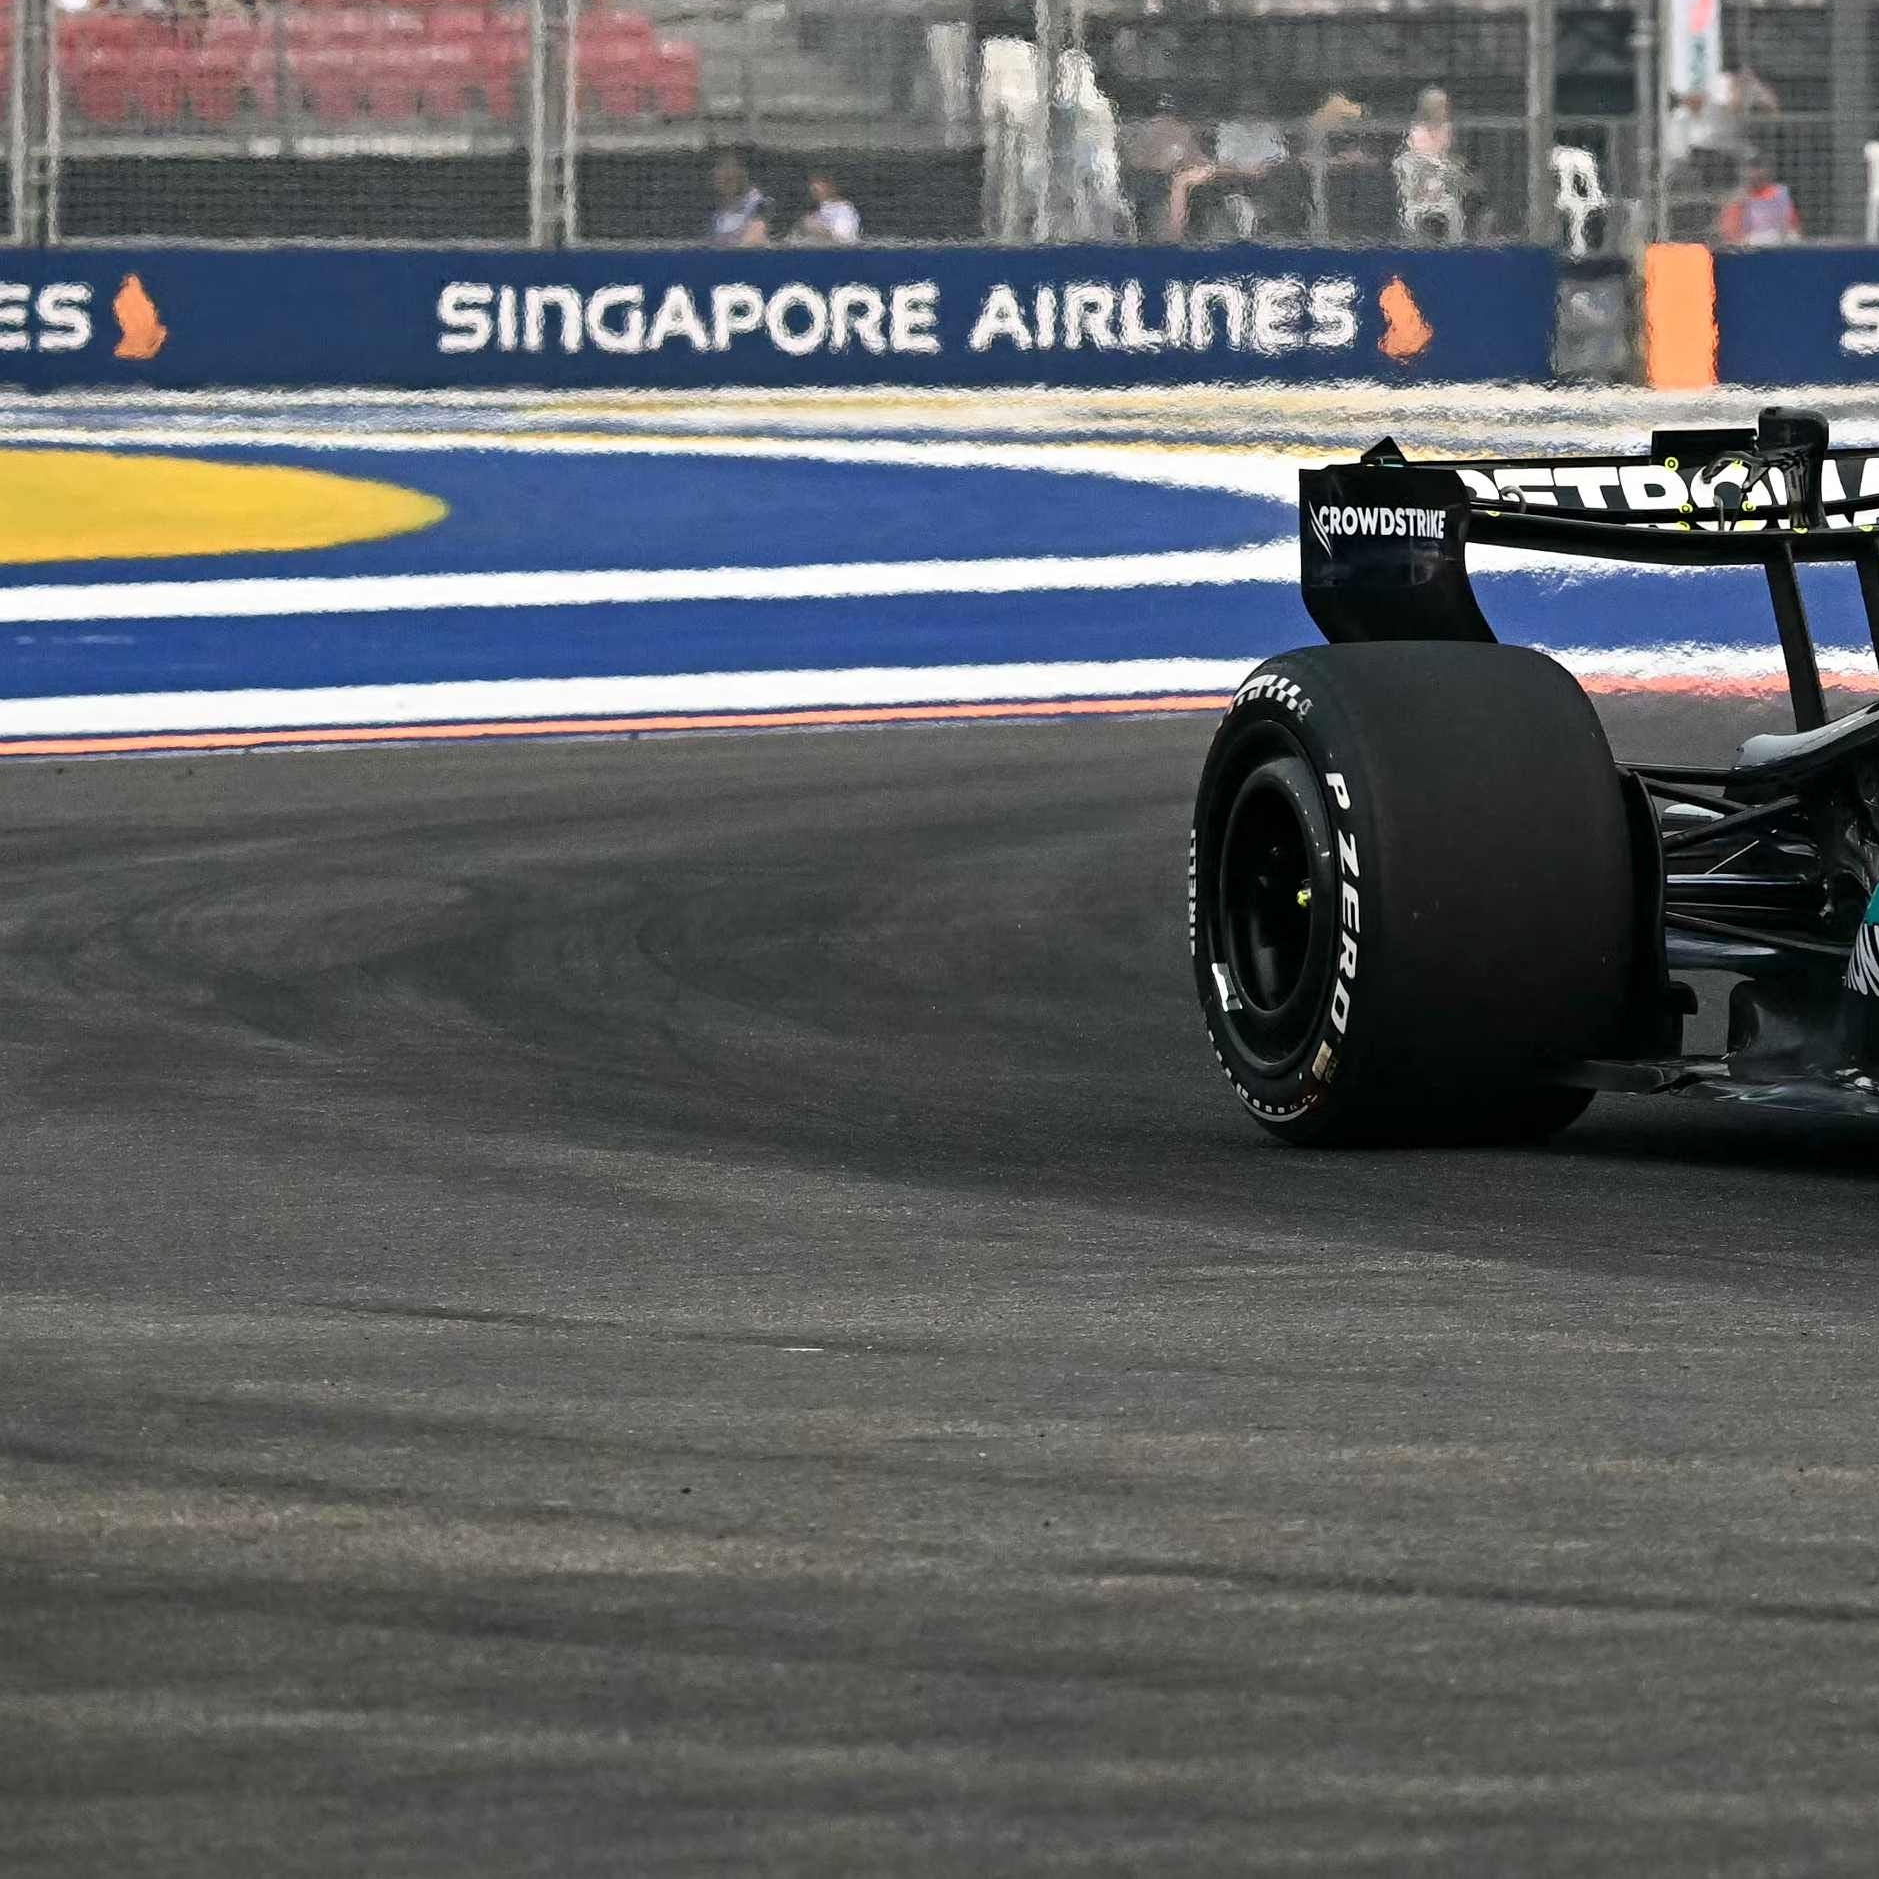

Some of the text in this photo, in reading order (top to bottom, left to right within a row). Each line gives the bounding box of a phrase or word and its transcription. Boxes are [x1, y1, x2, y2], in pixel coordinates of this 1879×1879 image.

[436, 275, 1360, 355] SINGAPORE AIRLINES
[1318, 505, 1446, 540] CROWDSTRIKE
[1325, 772, 1361, 1035] P ZERO
